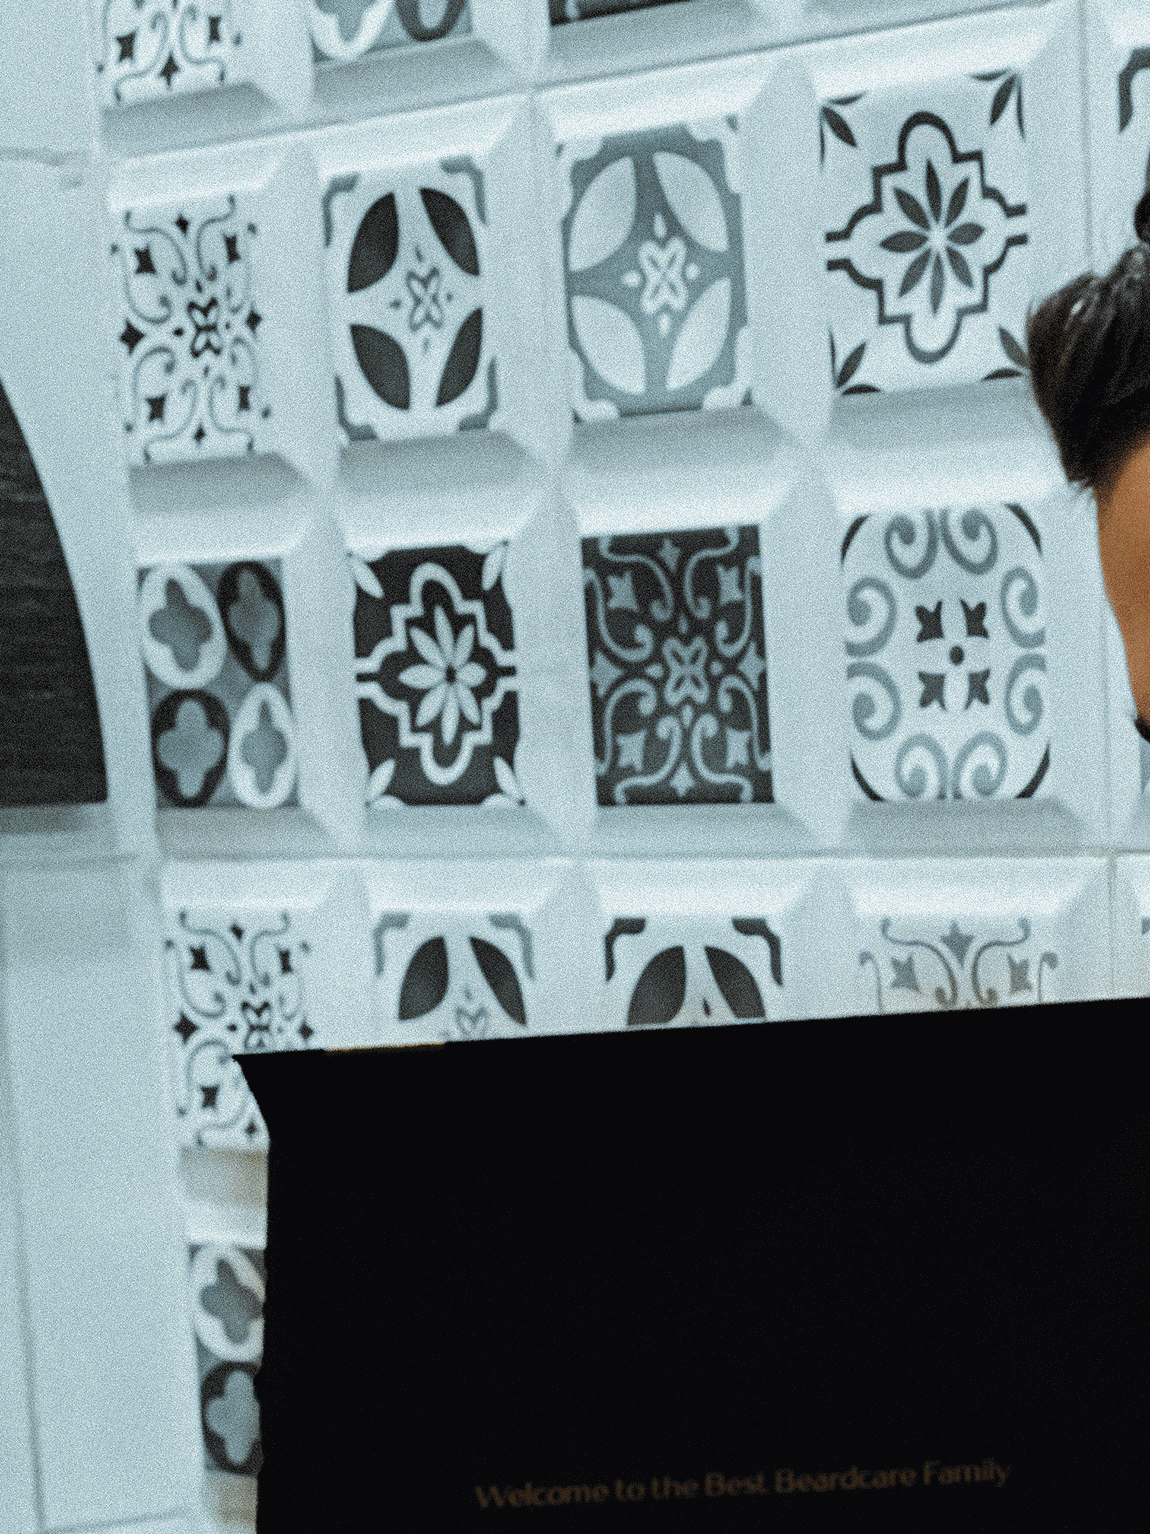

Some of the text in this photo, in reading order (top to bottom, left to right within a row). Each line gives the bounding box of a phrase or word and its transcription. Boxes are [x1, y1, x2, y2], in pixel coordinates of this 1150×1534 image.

[474, 1459, 1009, 1509] Welcome to the Best Beardcare Family
